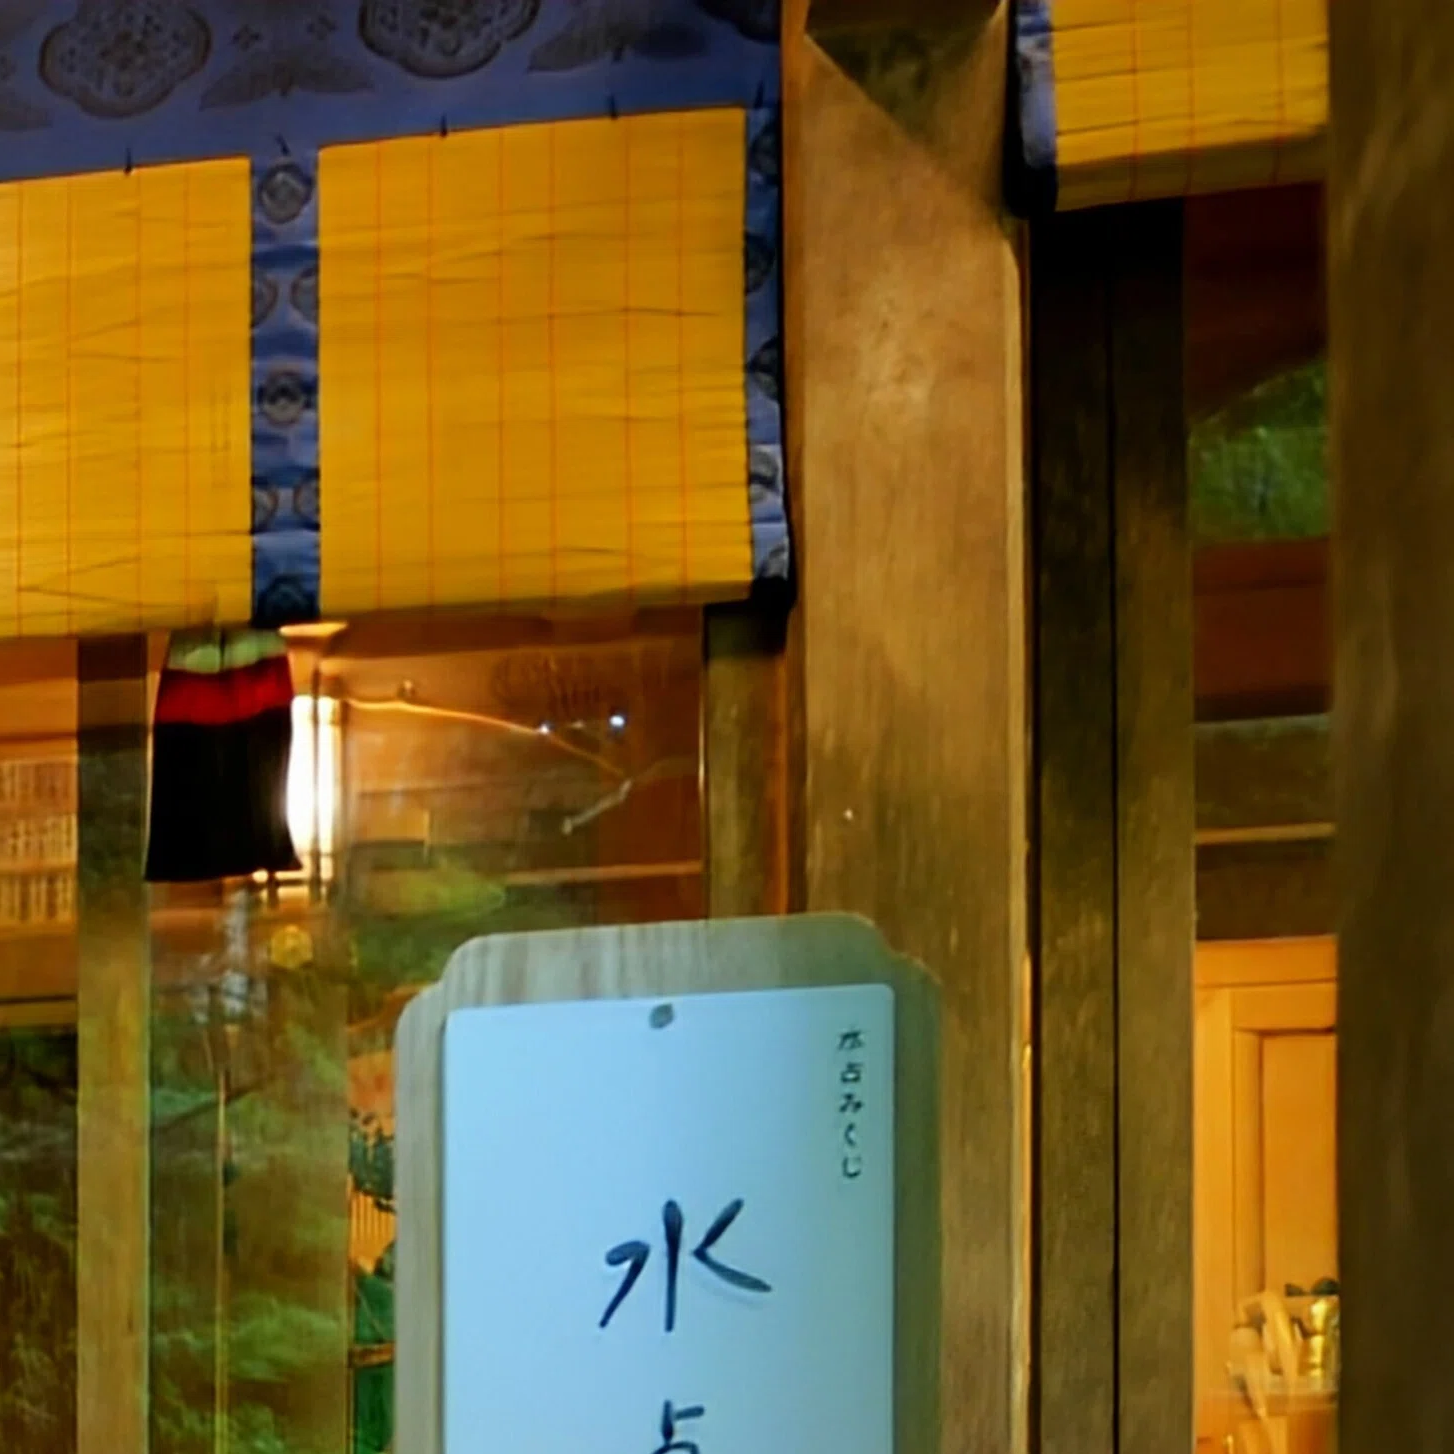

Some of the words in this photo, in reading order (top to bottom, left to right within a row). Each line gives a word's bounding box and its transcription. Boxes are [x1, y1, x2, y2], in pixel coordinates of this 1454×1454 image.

[839, 1028, 865, 1178] 水占みくじ
